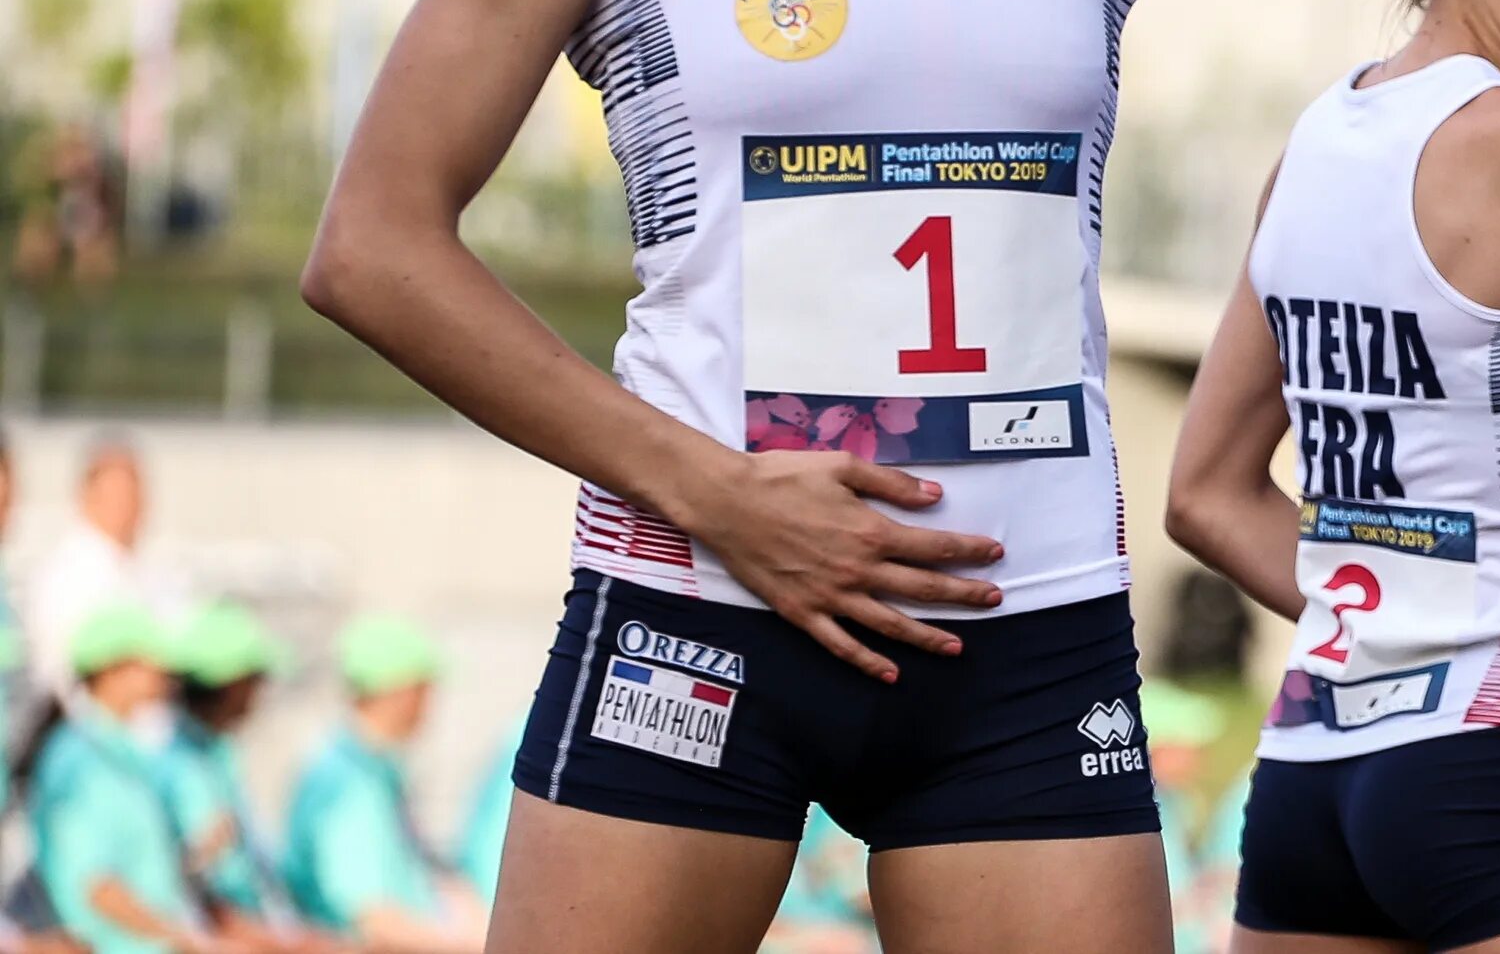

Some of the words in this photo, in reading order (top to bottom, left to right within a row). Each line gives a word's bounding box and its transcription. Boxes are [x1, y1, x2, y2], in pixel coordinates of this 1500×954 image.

[780, 145, 867, 172] UIPM
[882, 142, 993, 162] Pentathlon
[998, 142, 1048, 160] World
[1050, 143, 1076, 163] Cup
[882, 163, 931, 182] Final
[935, 162, 1006, 181] TOKYO
[1009, 162, 1046, 180] 2019
[893, 216, 987, 374] 1
[1265, 296, 1447, 399] OTEIZA
[984, 435, 1060, 445] ICONIQ
[1300, 401, 1406, 499] FRA
[1352, 524, 1399, 544] TOKYO
[1389, 512, 1433, 531] World
[1434, 516, 1469, 535] Cup
[1308, 563, 1381, 663] 2
[621, 622, 742, 680] OREZZA
[601, 683, 725, 747] PENTATHLON
[1080, 747, 1144, 777] errea
